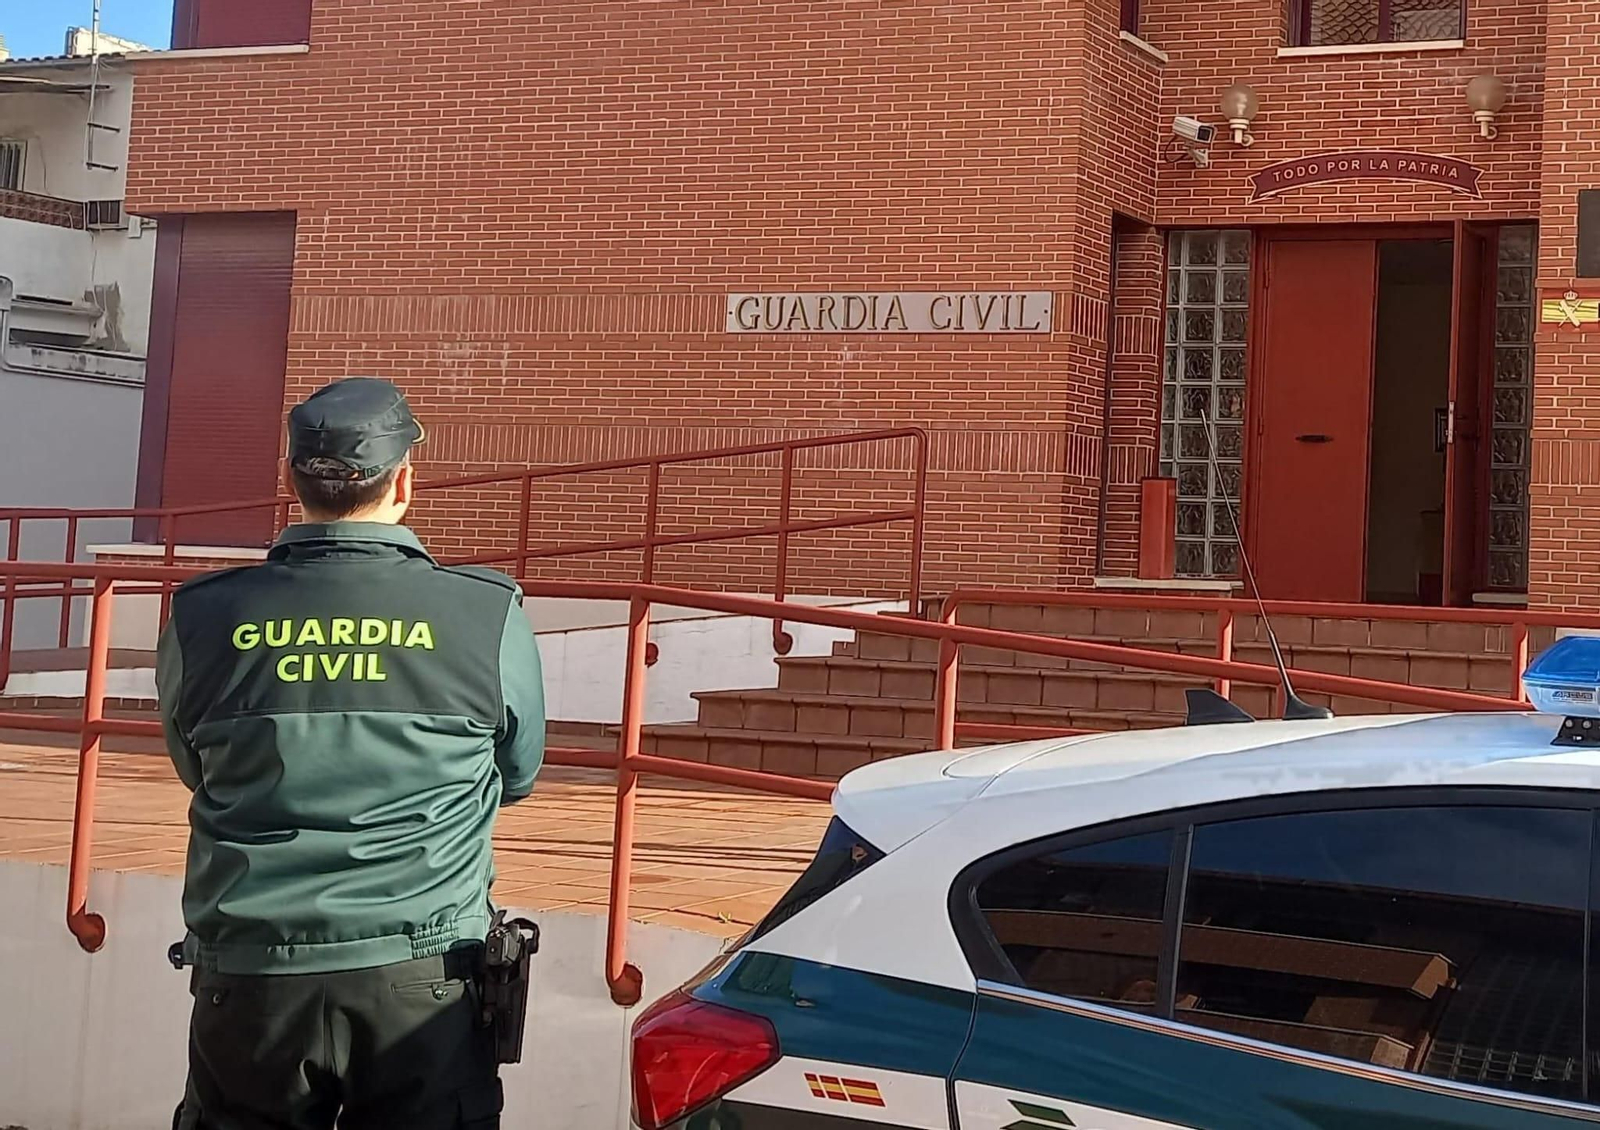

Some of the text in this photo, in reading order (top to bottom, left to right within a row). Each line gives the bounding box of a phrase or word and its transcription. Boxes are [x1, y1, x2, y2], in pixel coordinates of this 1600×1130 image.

[1273, 159, 1458, 182] TODO POR LA PATRIA
[733, 294, 1041, 331] GUARDIA CIVIL
[231, 617, 435, 650] GUARDIA
[275, 652, 387, 682] CIVIL
